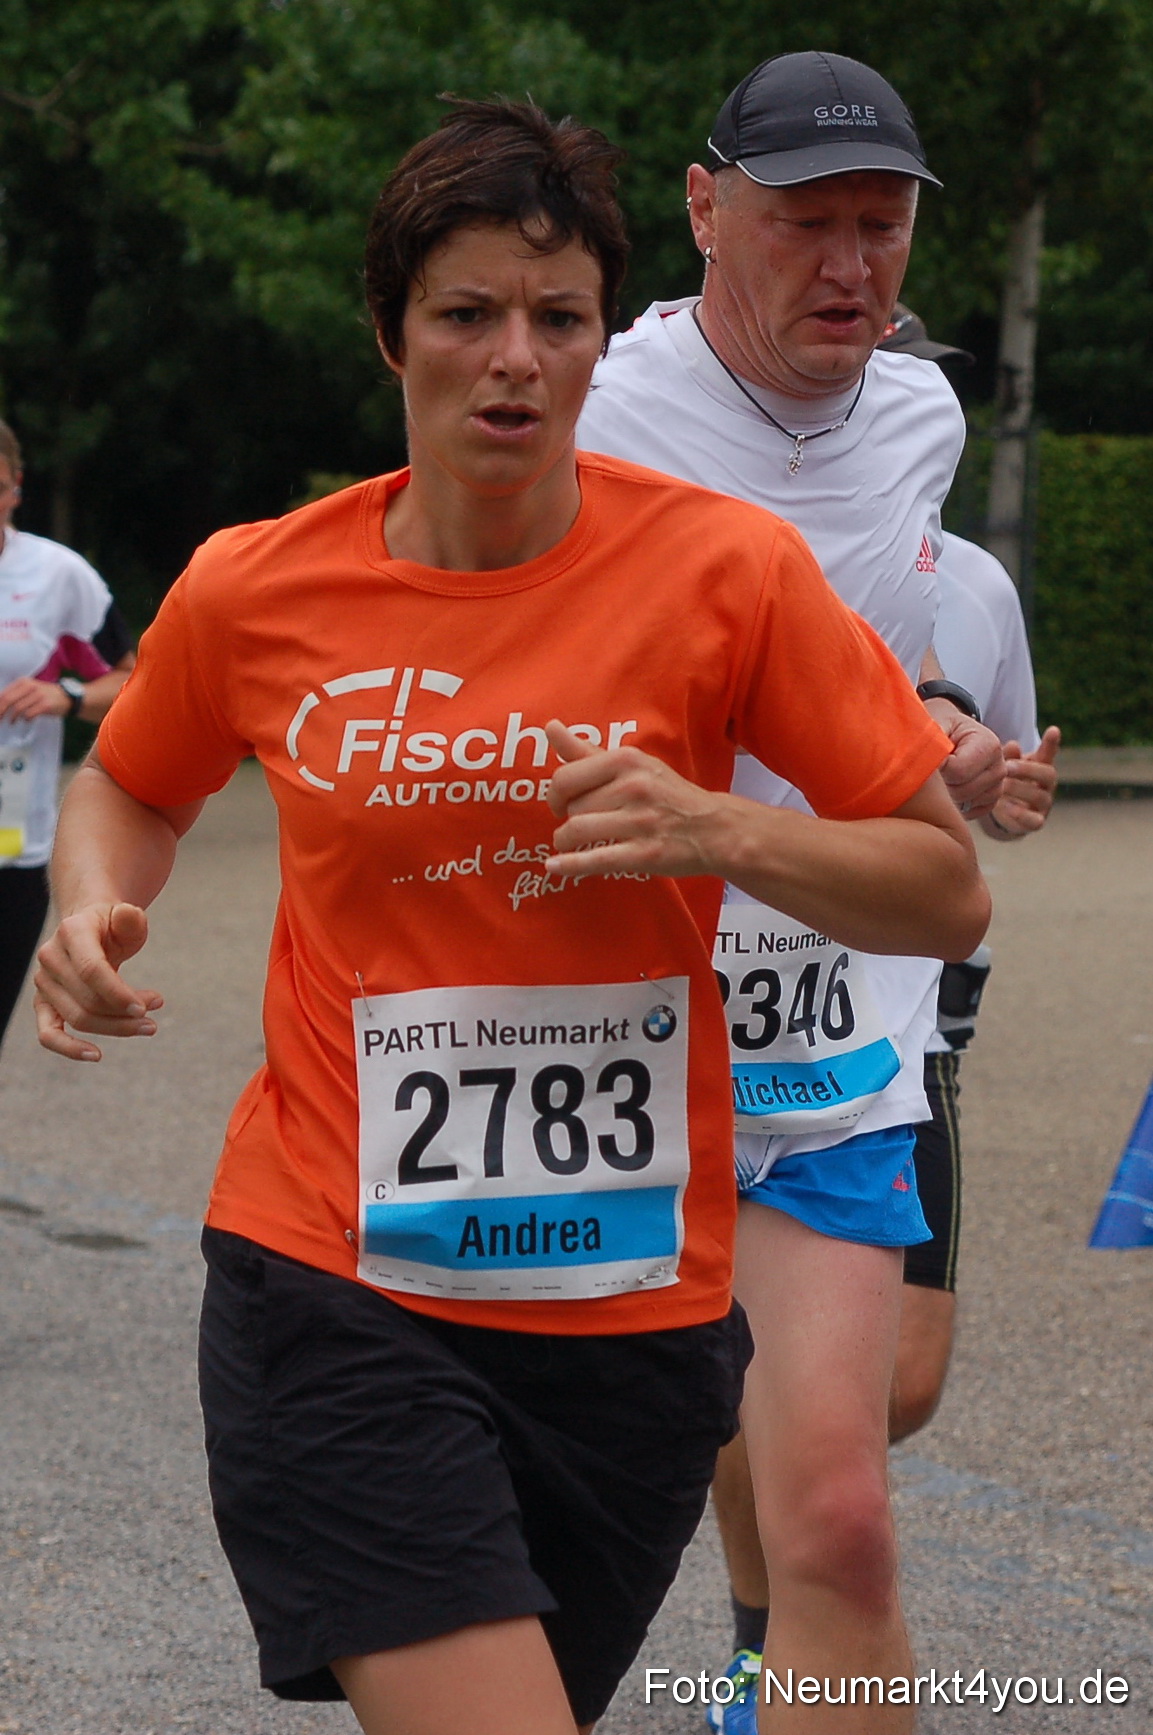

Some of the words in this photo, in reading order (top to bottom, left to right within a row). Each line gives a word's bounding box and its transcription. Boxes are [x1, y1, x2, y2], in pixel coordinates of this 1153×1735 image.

[814, 104, 876, 118] GORE
[365, 779, 550, 806] AUTOMOB
[424, 844, 482, 881] und
[714, 952, 855, 1050] 346
[364, 1021, 468, 1056] PARTL
[477, 1017, 630, 1047] Neumarkt
[395, 1058, 655, 1186] 2783
[456, 1212, 602, 1258] Andrea
